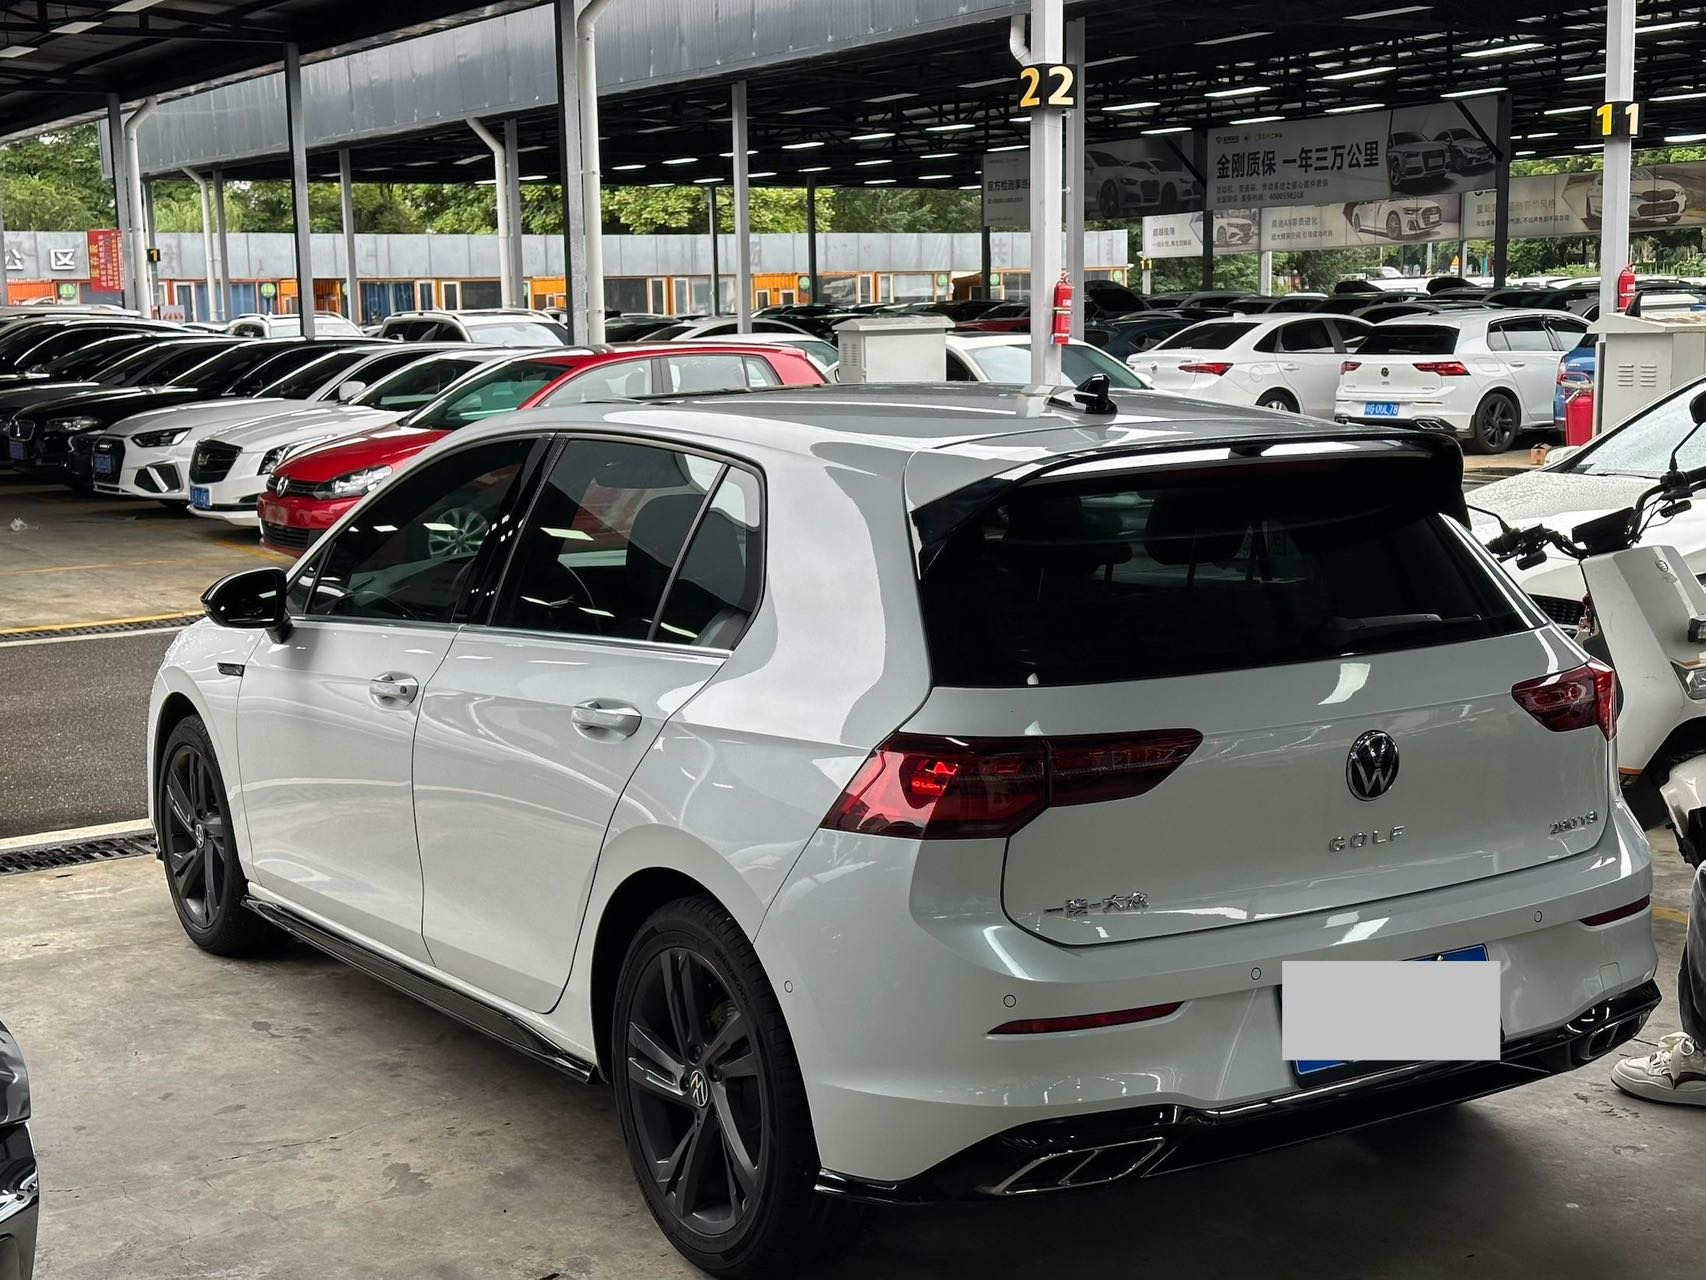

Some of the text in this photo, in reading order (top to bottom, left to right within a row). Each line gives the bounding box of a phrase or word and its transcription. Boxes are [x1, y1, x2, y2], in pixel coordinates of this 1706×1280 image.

[1216, 140, 1379, 179] 金刚质保 一年三万公里
[1328, 825, 1405, 852] GOLF
